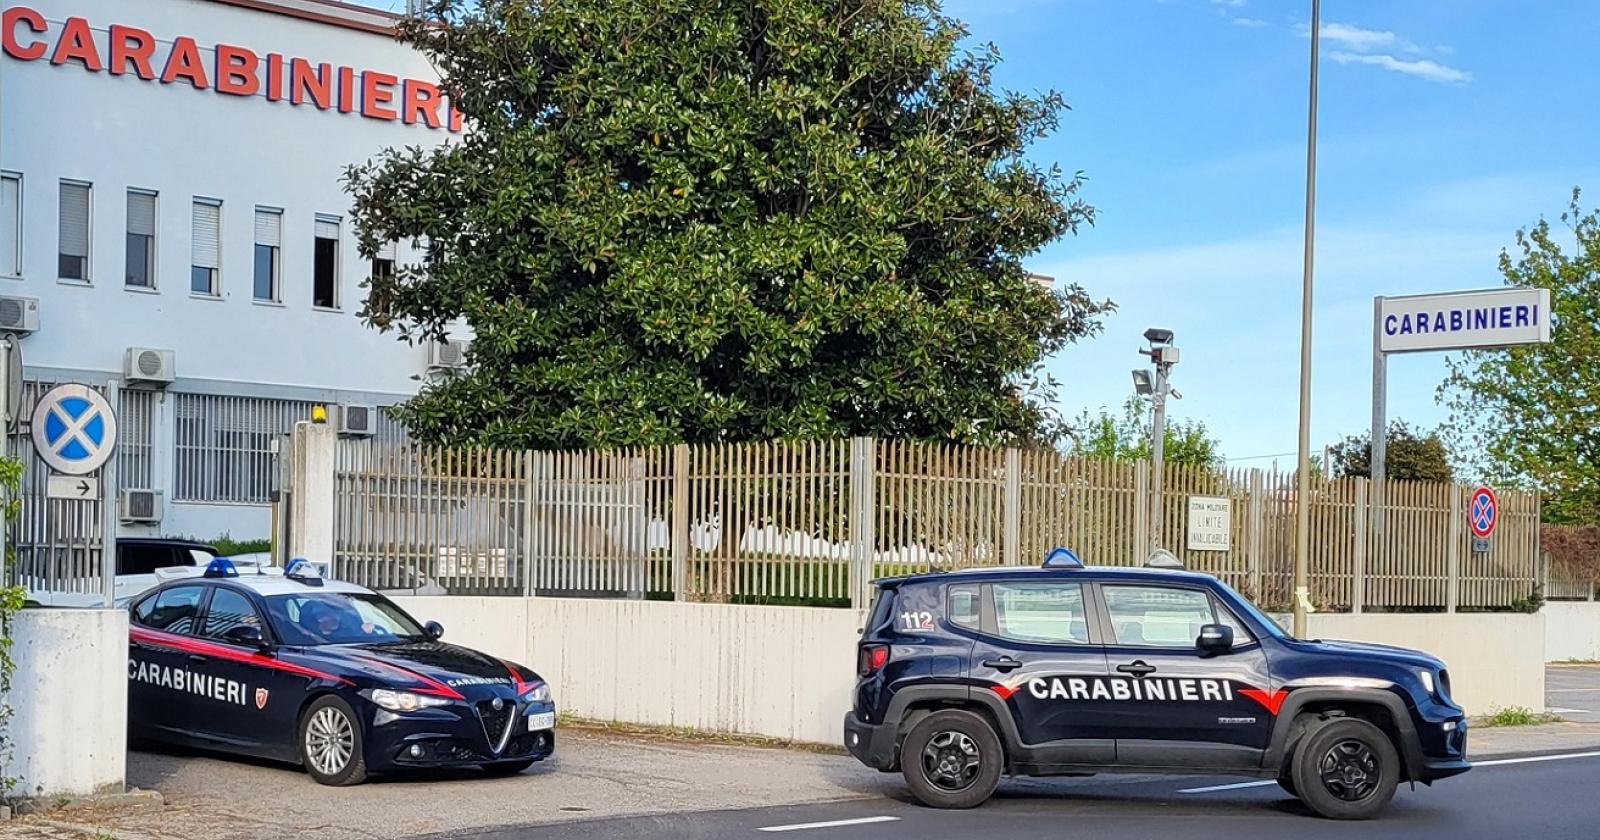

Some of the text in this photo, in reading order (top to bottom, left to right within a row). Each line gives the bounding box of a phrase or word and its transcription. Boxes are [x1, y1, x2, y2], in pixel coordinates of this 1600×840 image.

[1385, 304, 1538, 336] CARABINIERI
[901, 611, 935, 629] 112
[128, 658, 247, 706] CARABINIERI
[1028, 678, 1234, 701] CARABINIERI
